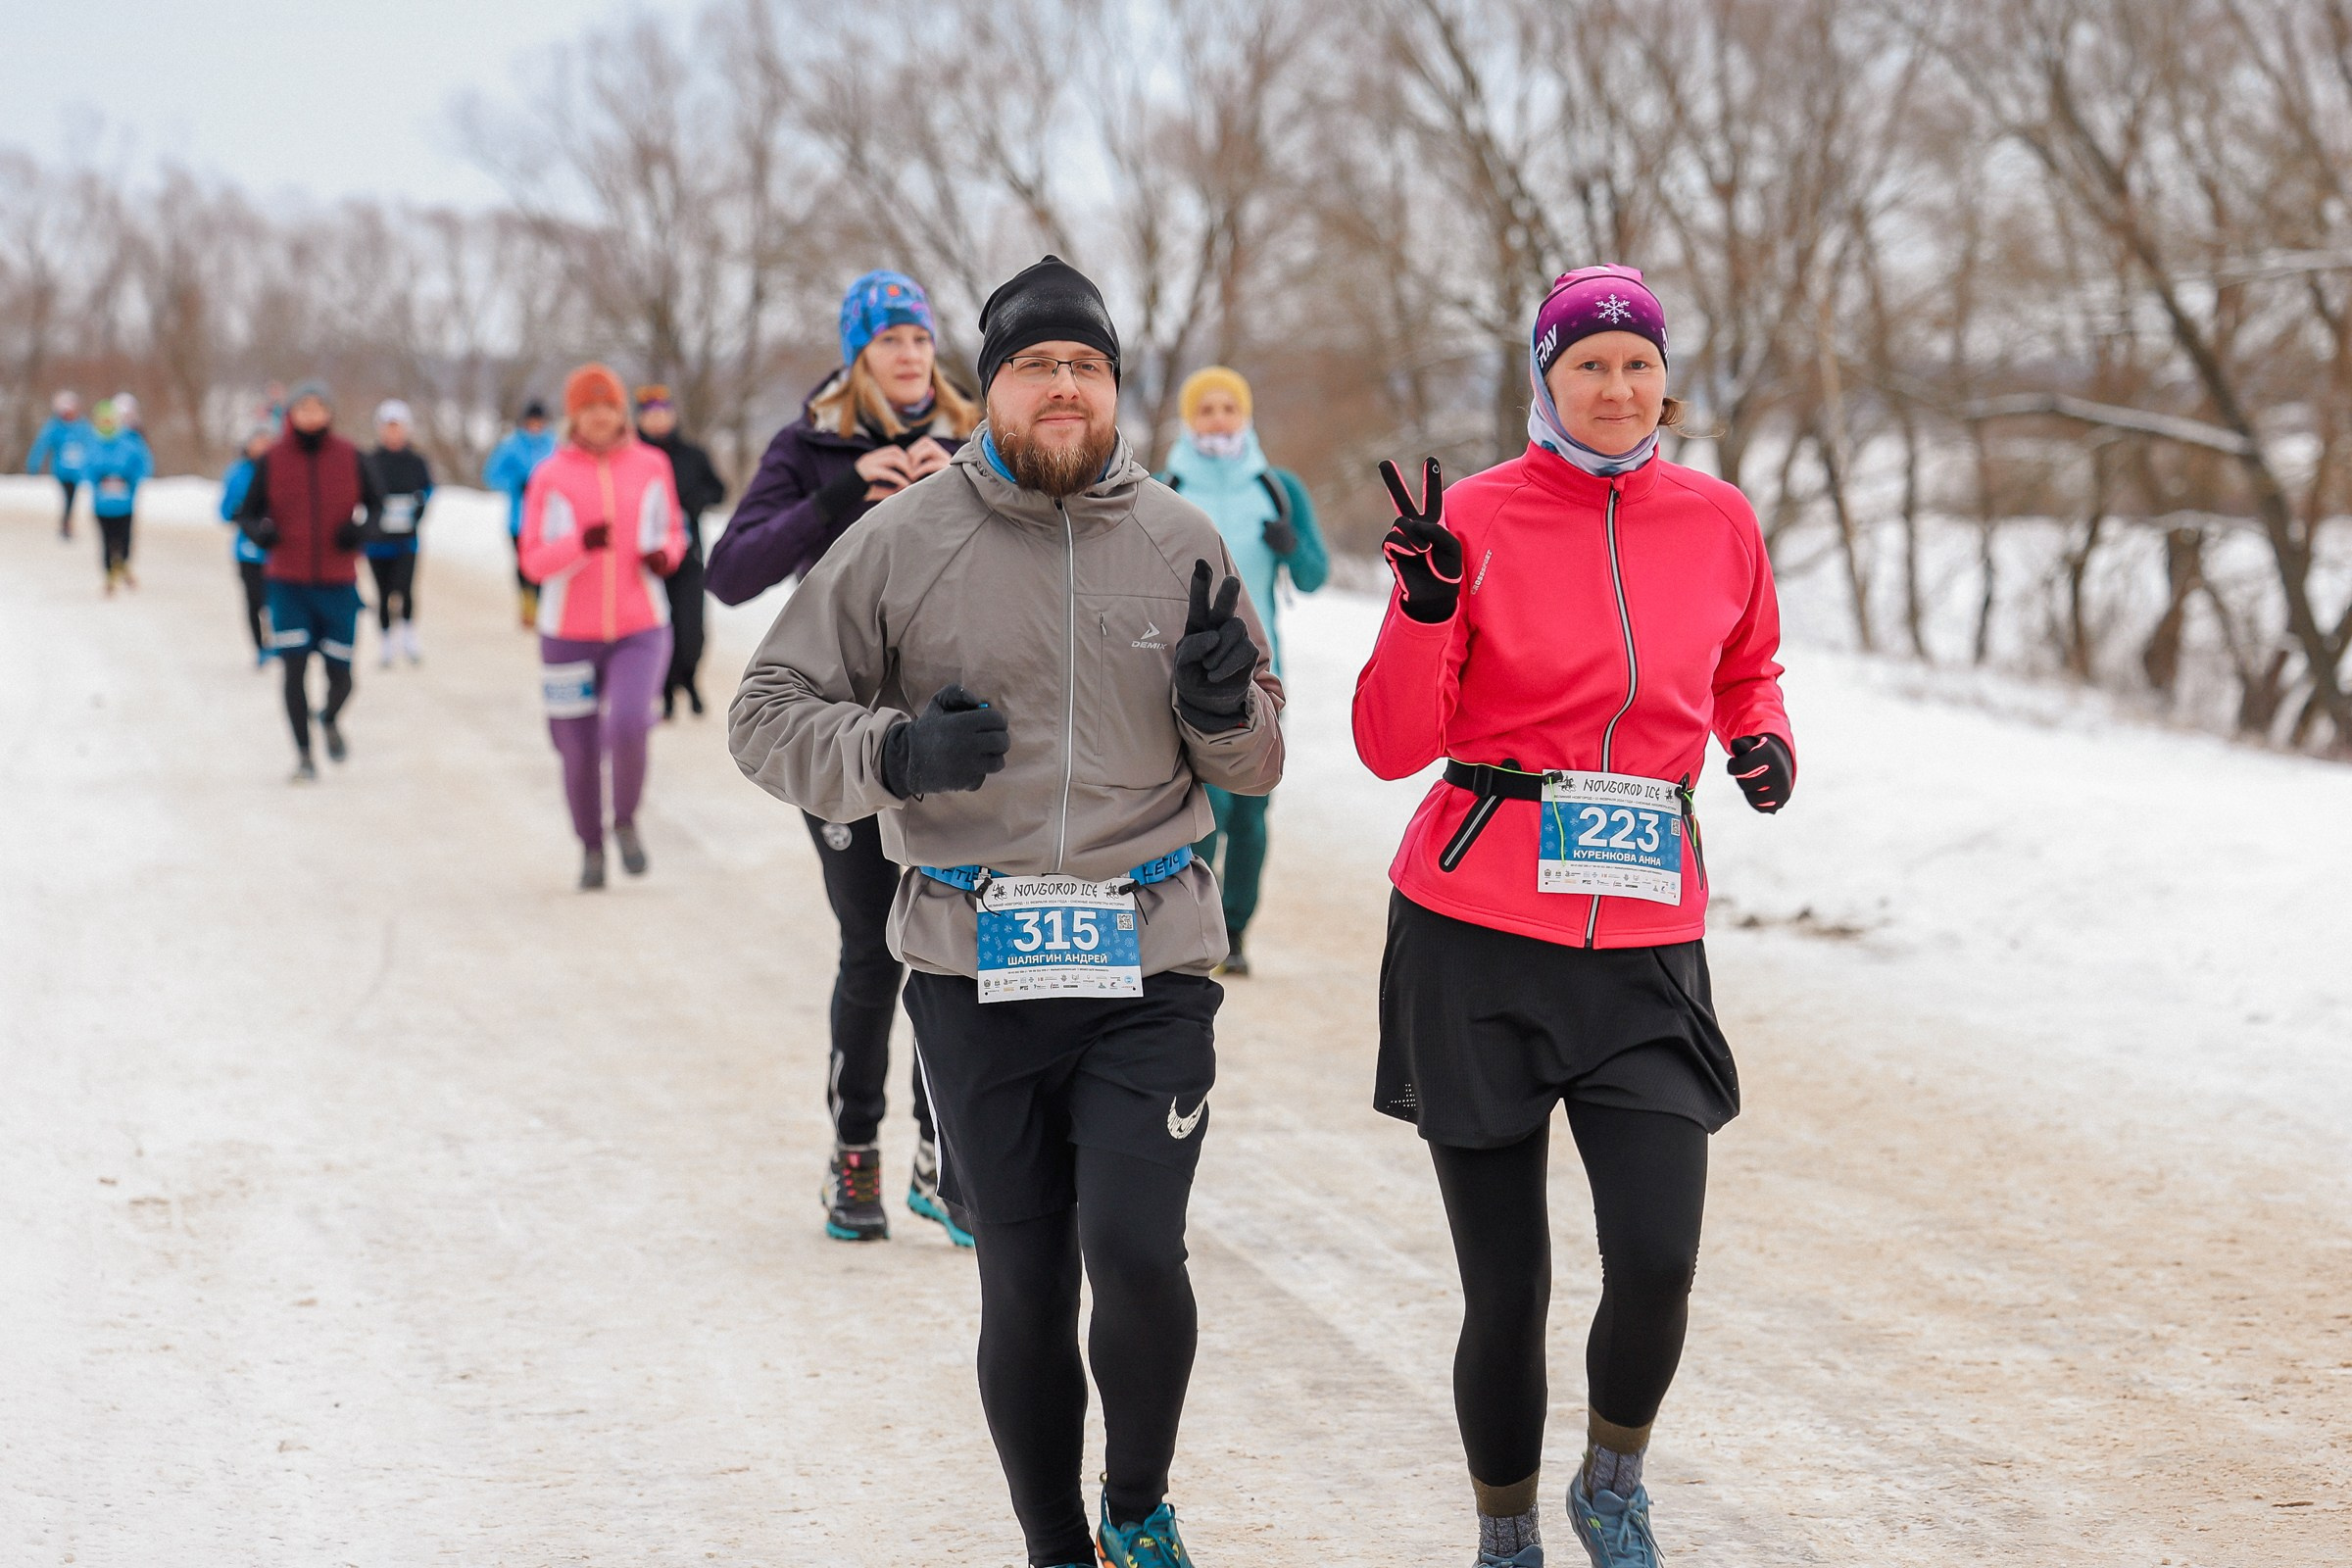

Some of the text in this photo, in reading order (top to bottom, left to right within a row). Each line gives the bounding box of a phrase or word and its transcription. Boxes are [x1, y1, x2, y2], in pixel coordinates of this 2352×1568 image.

[1131, 640, 1167, 650] DEMIX
[1583, 778, 1660, 801] NOVGOROD ICE
[1578, 807, 1660, 853] 223
[1573, 850, 1661, 867] КУРЕНКОВА АННА
[1013, 883, 1098, 897] NOVGOROD ICE
[1013, 909, 1100, 952] 315
[1007, 953, 1107, 965] ШАЛЯГИН АНДРЕЙ
